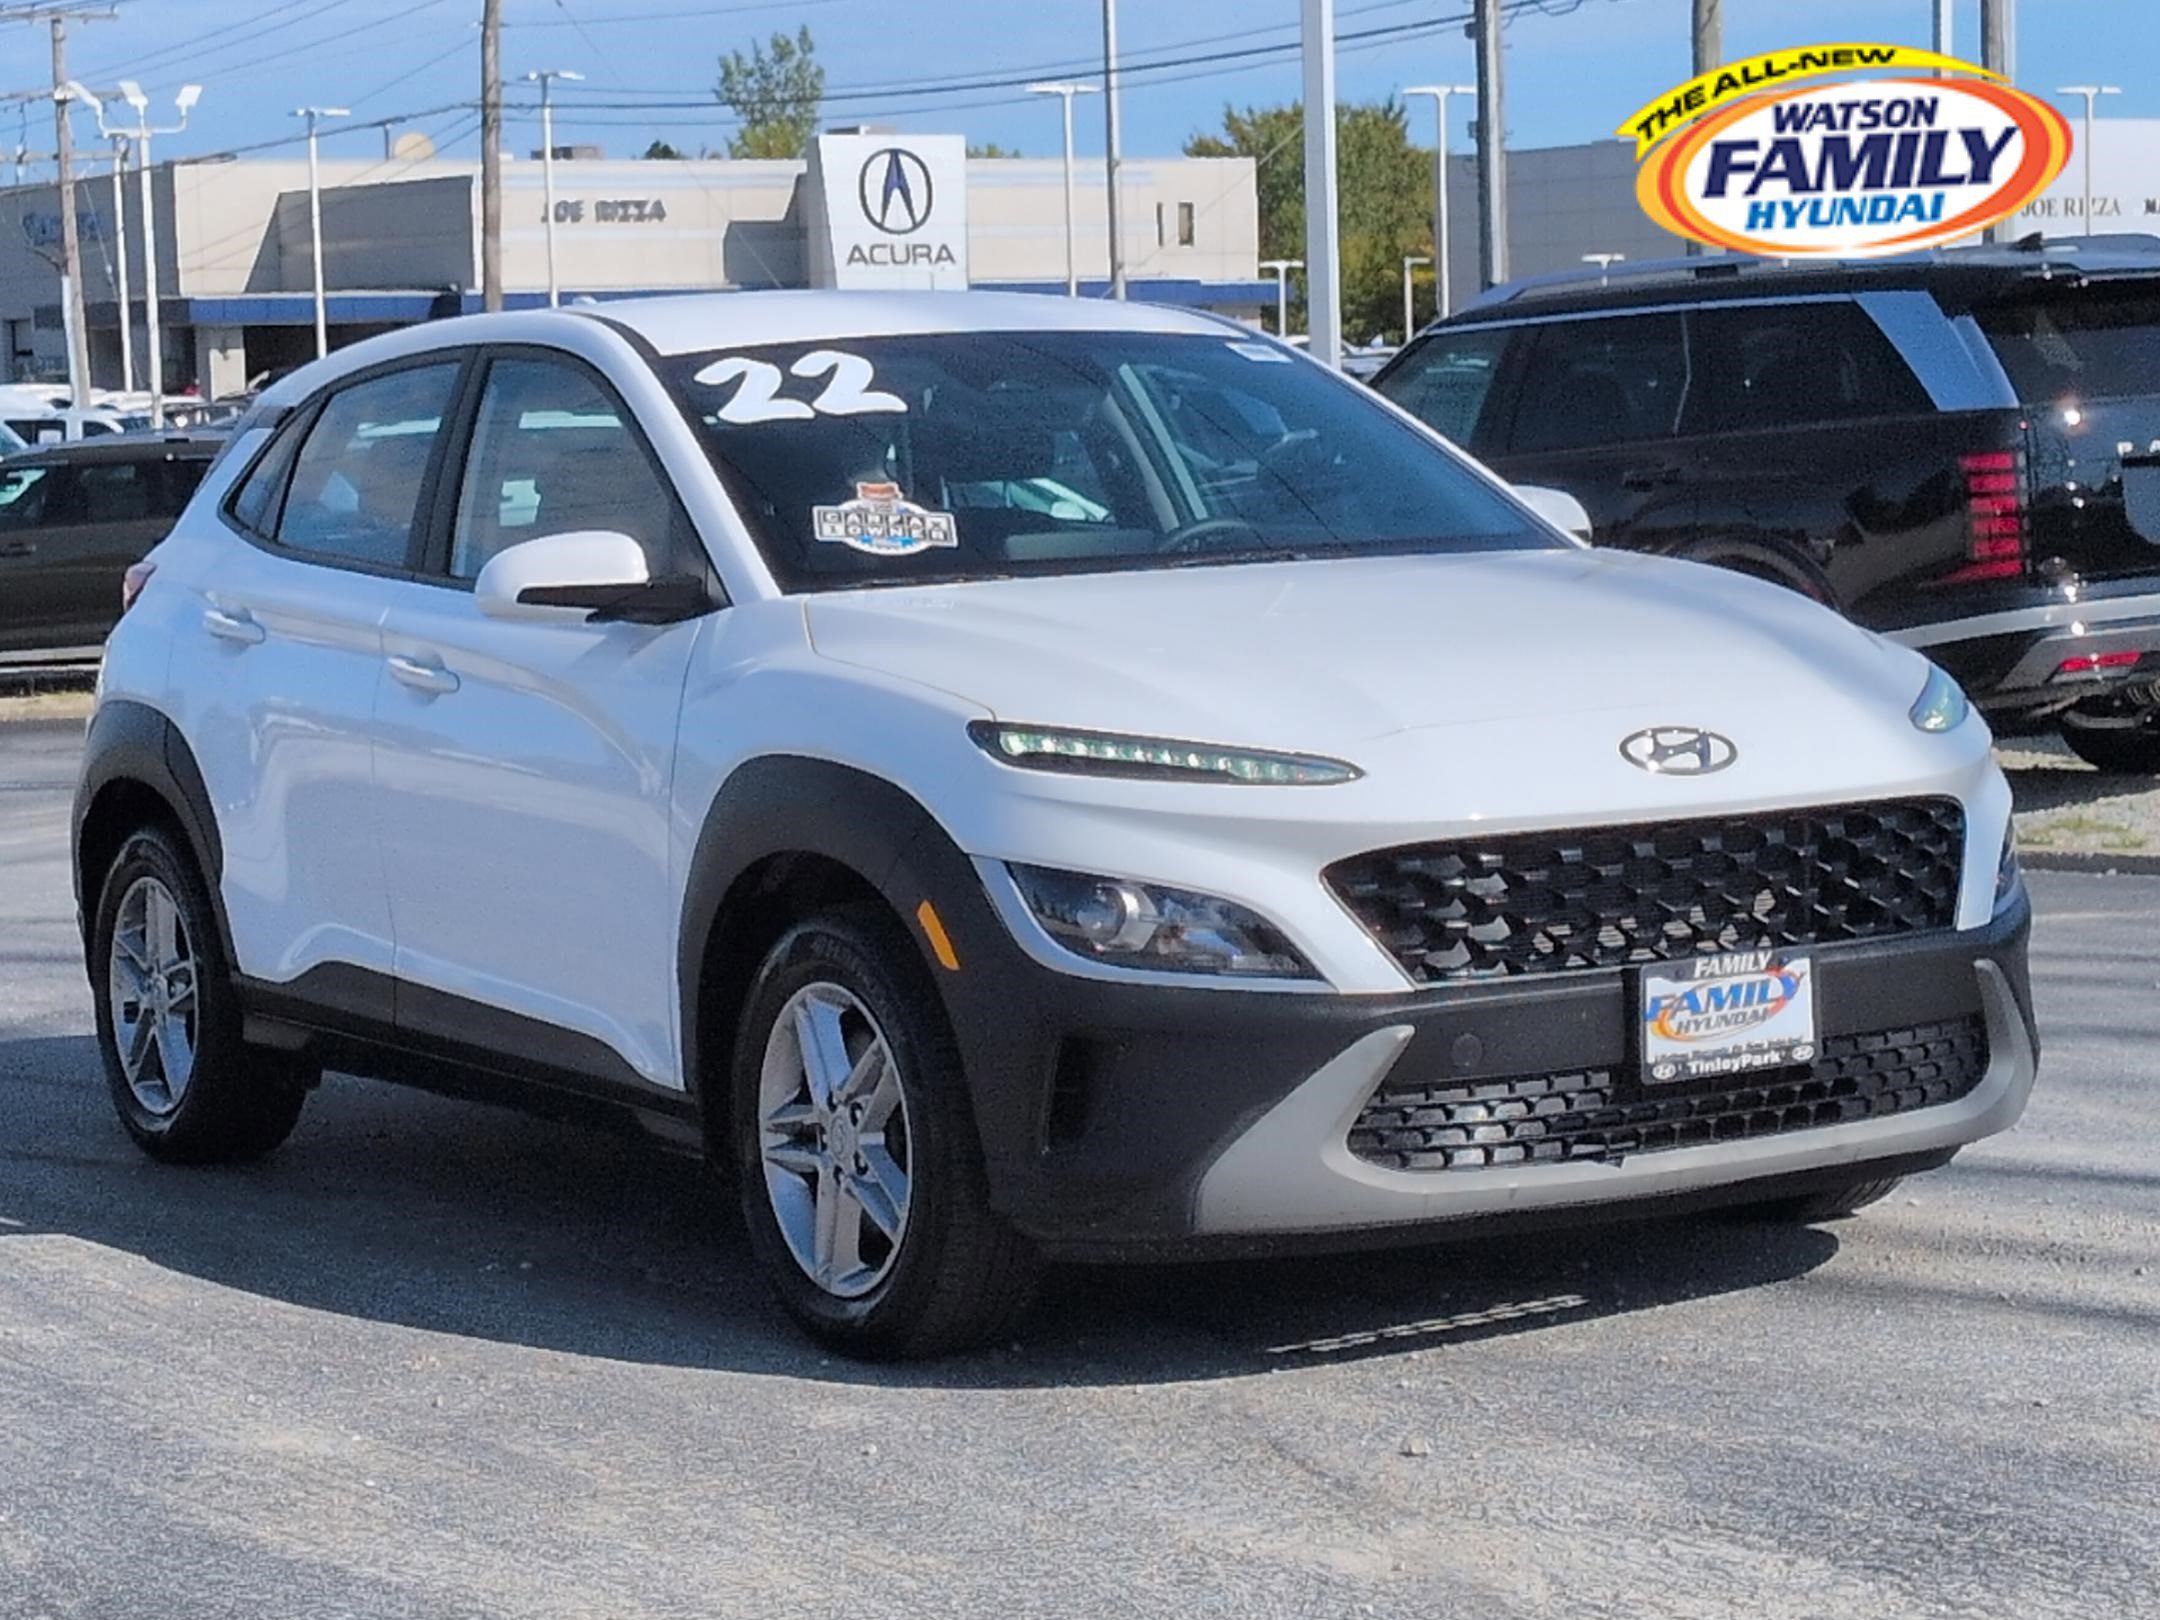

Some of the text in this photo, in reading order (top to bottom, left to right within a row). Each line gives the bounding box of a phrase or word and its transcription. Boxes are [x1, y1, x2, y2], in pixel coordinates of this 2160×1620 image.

[2021, 197, 2058, 217] JOE
[846, 243, 956, 266] ACURA
[694, 350, 909, 424] 22
[1694, 950, 1774, 978] FAMILY
[1675, 1006, 1770, 1035] HYUNDAI
